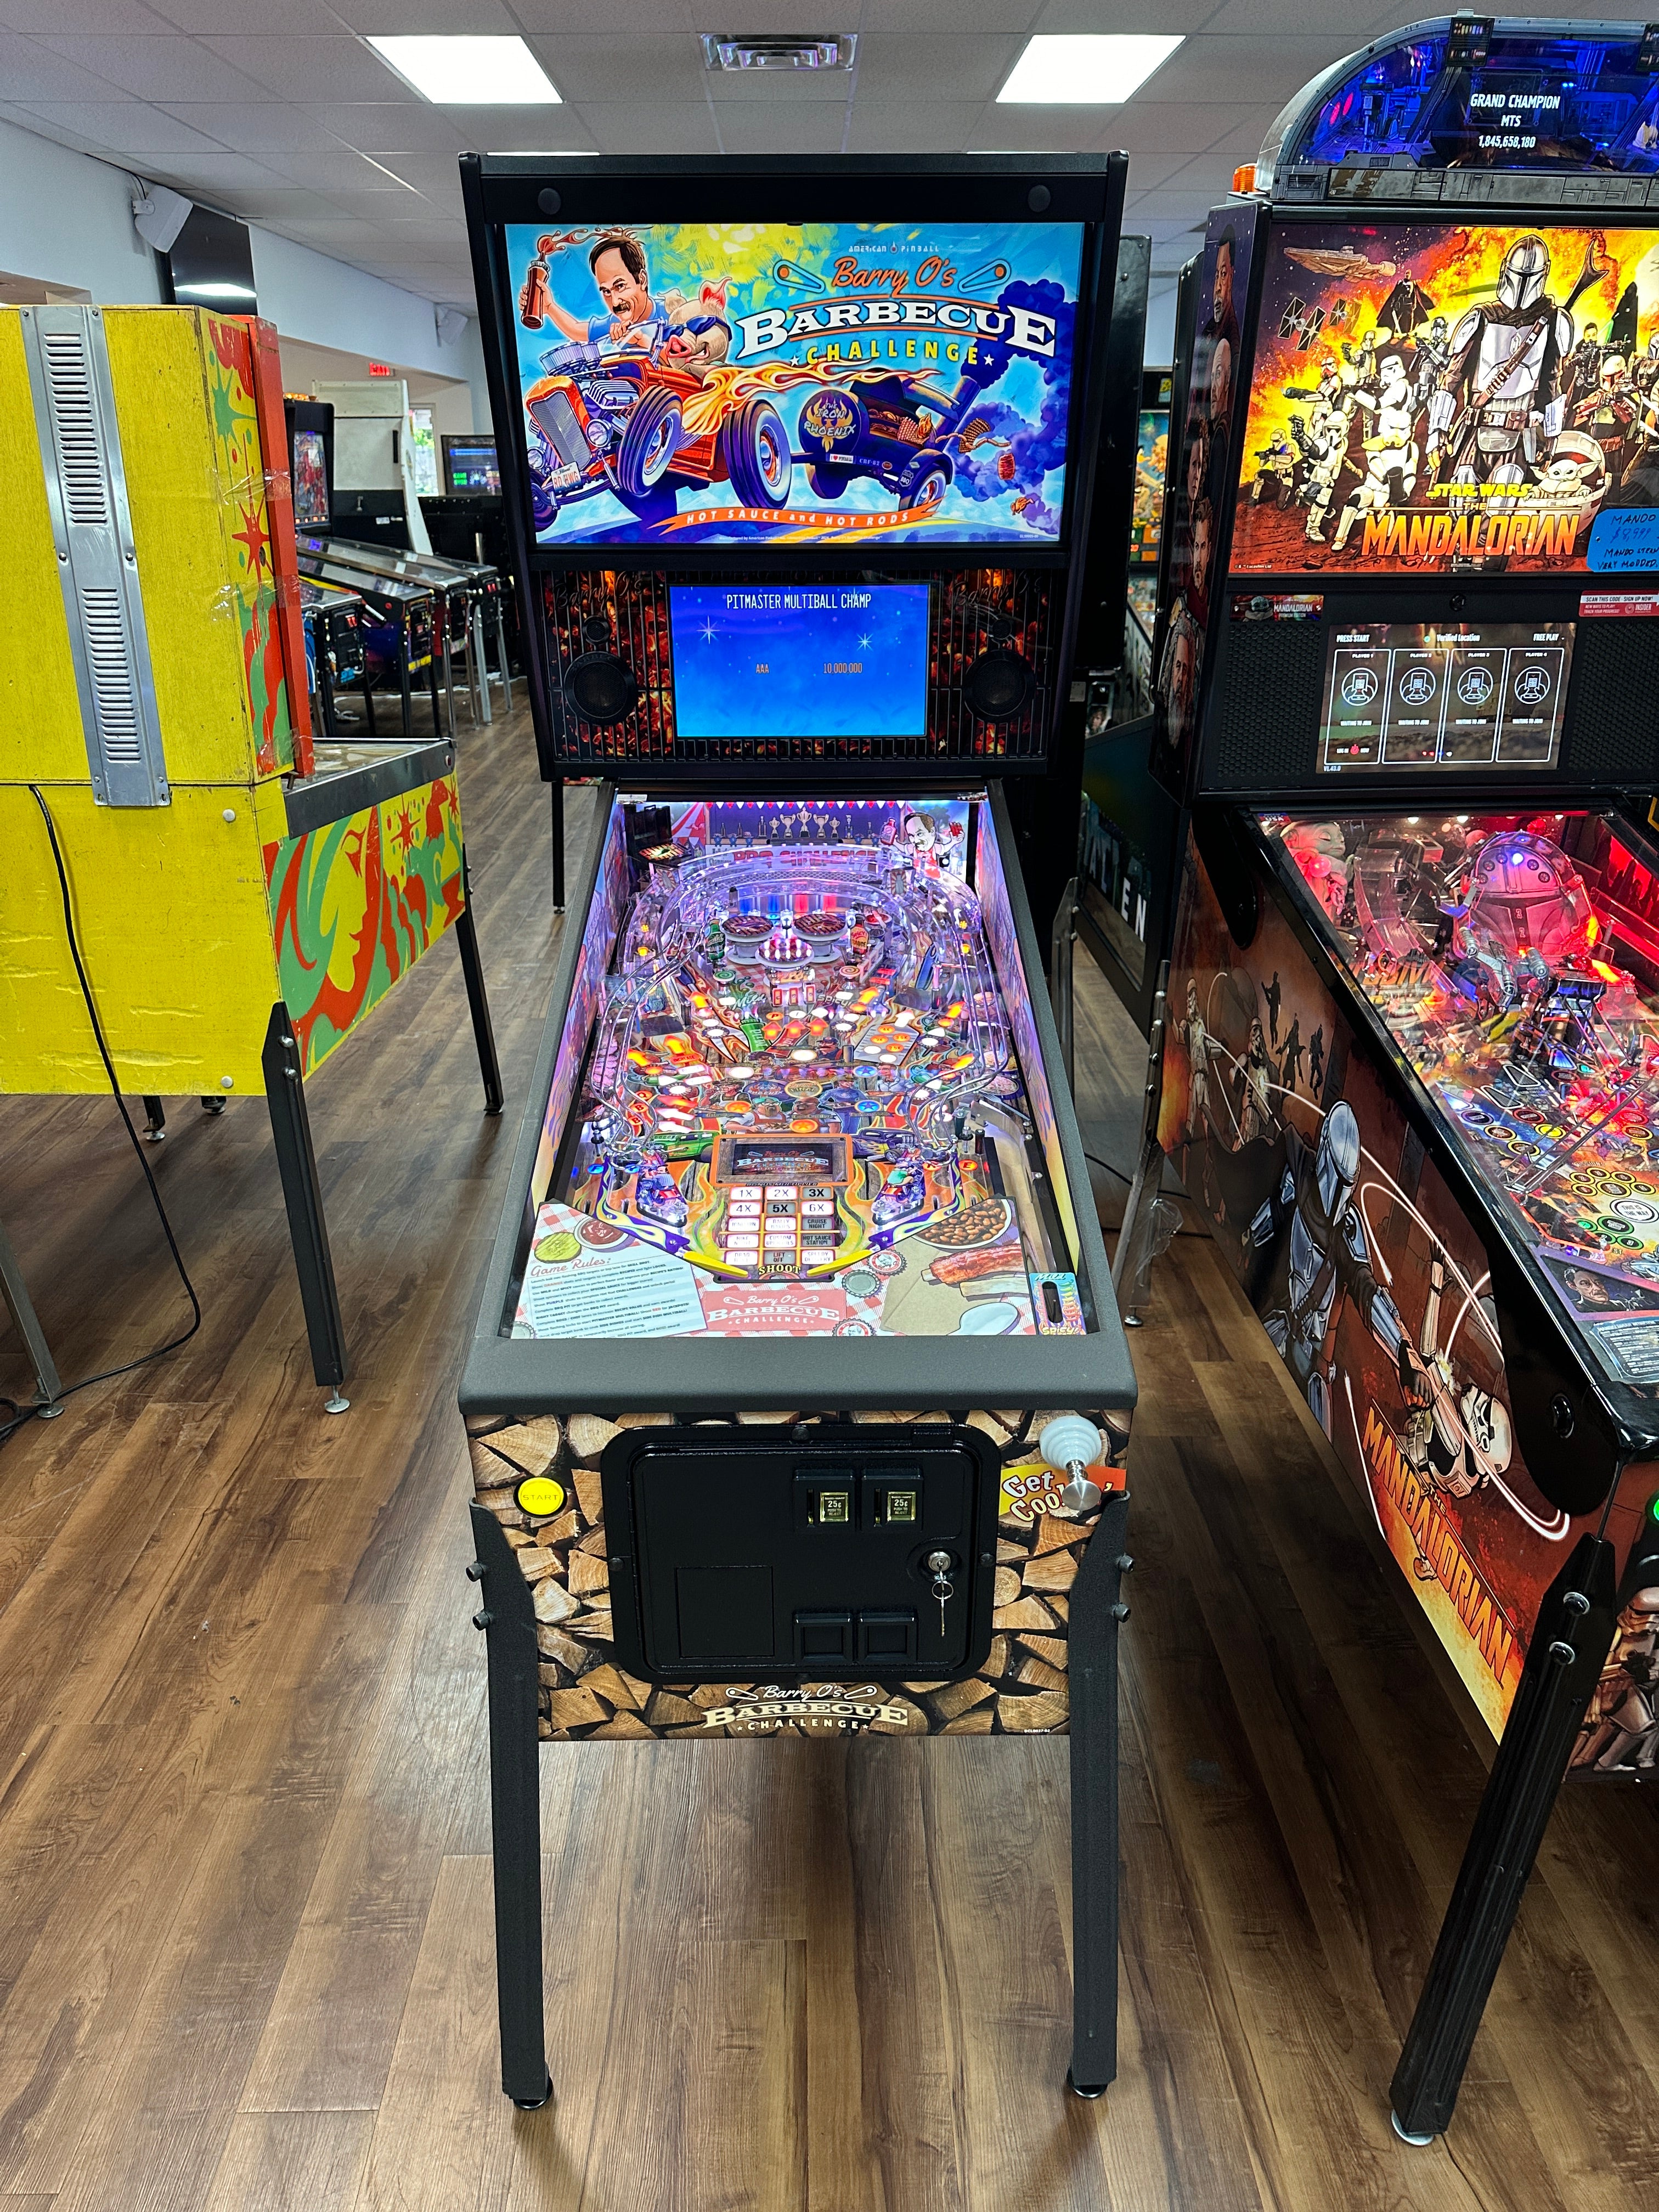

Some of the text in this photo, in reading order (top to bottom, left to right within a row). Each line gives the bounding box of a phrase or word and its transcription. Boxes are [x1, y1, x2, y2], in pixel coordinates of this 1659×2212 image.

[1470, 94, 1560, 109] GRAND CHAMPION
[1501, 115, 1521, 127] MTS
[1479, 136, 1536, 149] 1,845,658,180
[833, 257, 957, 297] Barry O's
[736, 301, 1056, 359] BARBECUE
[807, 339, 977, 365] CHALLENGE
[816, 408, 845, 419] IRON
[804, 421, 856, 436] PHOENIX
[1426, 483, 1534, 497] STAR WARS
[687, 509, 909, 526] HOT SAUCE and HOT RODS
[1611, 514, 1656, 525] MANDO
[1361, 515, 1580, 556] MANDALORIAN
[1610, 527, 1651, 544] $8,999
[1604, 548, 1634, 558] MANDO
[1598, 561, 1617, 571] VERY
[726, 593, 871, 609] PITMASTER MULTIBALL CHAMP
[1274, 604, 1312, 612] MANDALORIAN
[1437, 633, 1480, 642] Verified Location
[1533, 633, 1559, 641] FREE PLAY
[755, 663, 862, 674] AAA 10,000,000
[732, 993, 768, 1010] Mild
[737, 1157, 829, 1166] BARBECUE
[740, 1189, 753, 1198] 1X
[809, 1189, 825, 1197] 3X
[736, 1204, 824, 1212] 4X 5X 6X
[531, 1257, 611, 1277] Game Rules:
[758, 1264, 801, 1275] SHOOT
[747, 1295, 798, 1306] Barry O's
[707, 1306, 840, 1322] BARBECUE
[1002, 1470, 1054, 1498] Get
[1430, 1486, 1446, 1516] THE
[1362, 1407, 1514, 1683] MANDALORIAN
[763, 1684, 844, 1703] Barry O's
[701, 1702, 909, 1729] BARBECUE
[748, 1718, 859, 1730] CHALLENGE
